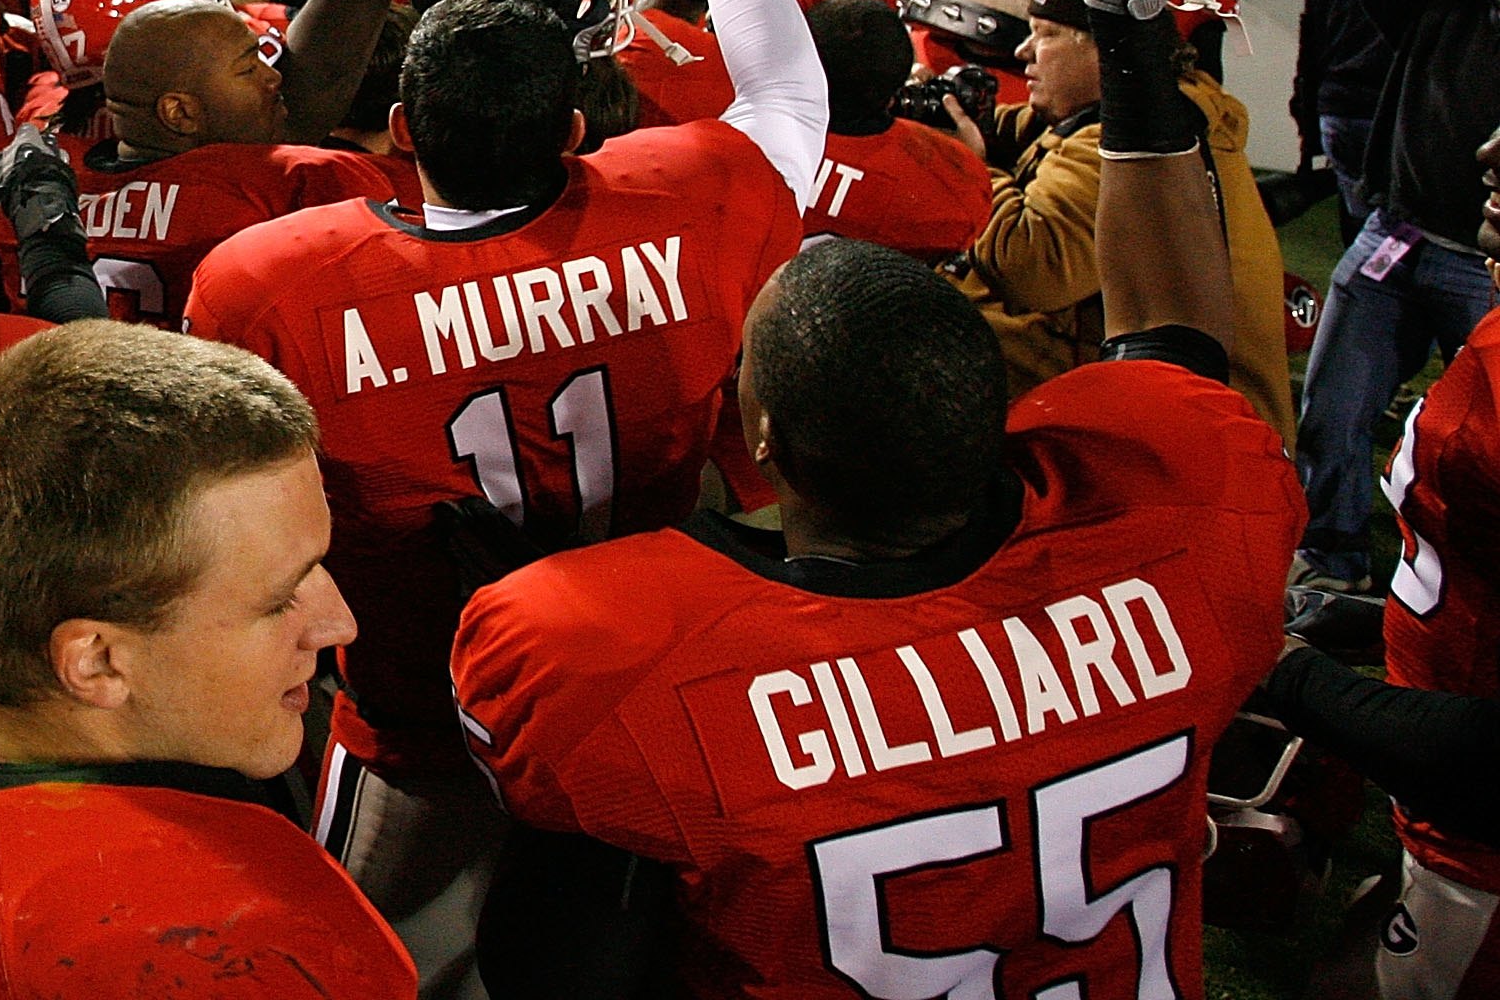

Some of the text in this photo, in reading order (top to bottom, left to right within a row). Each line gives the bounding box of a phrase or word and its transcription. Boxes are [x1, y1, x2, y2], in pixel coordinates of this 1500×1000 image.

[343, 236, 689, 394] A. MURRAY
[447, 364, 616, 546] 11
[748, 577, 1193, 791] GILLIARD
